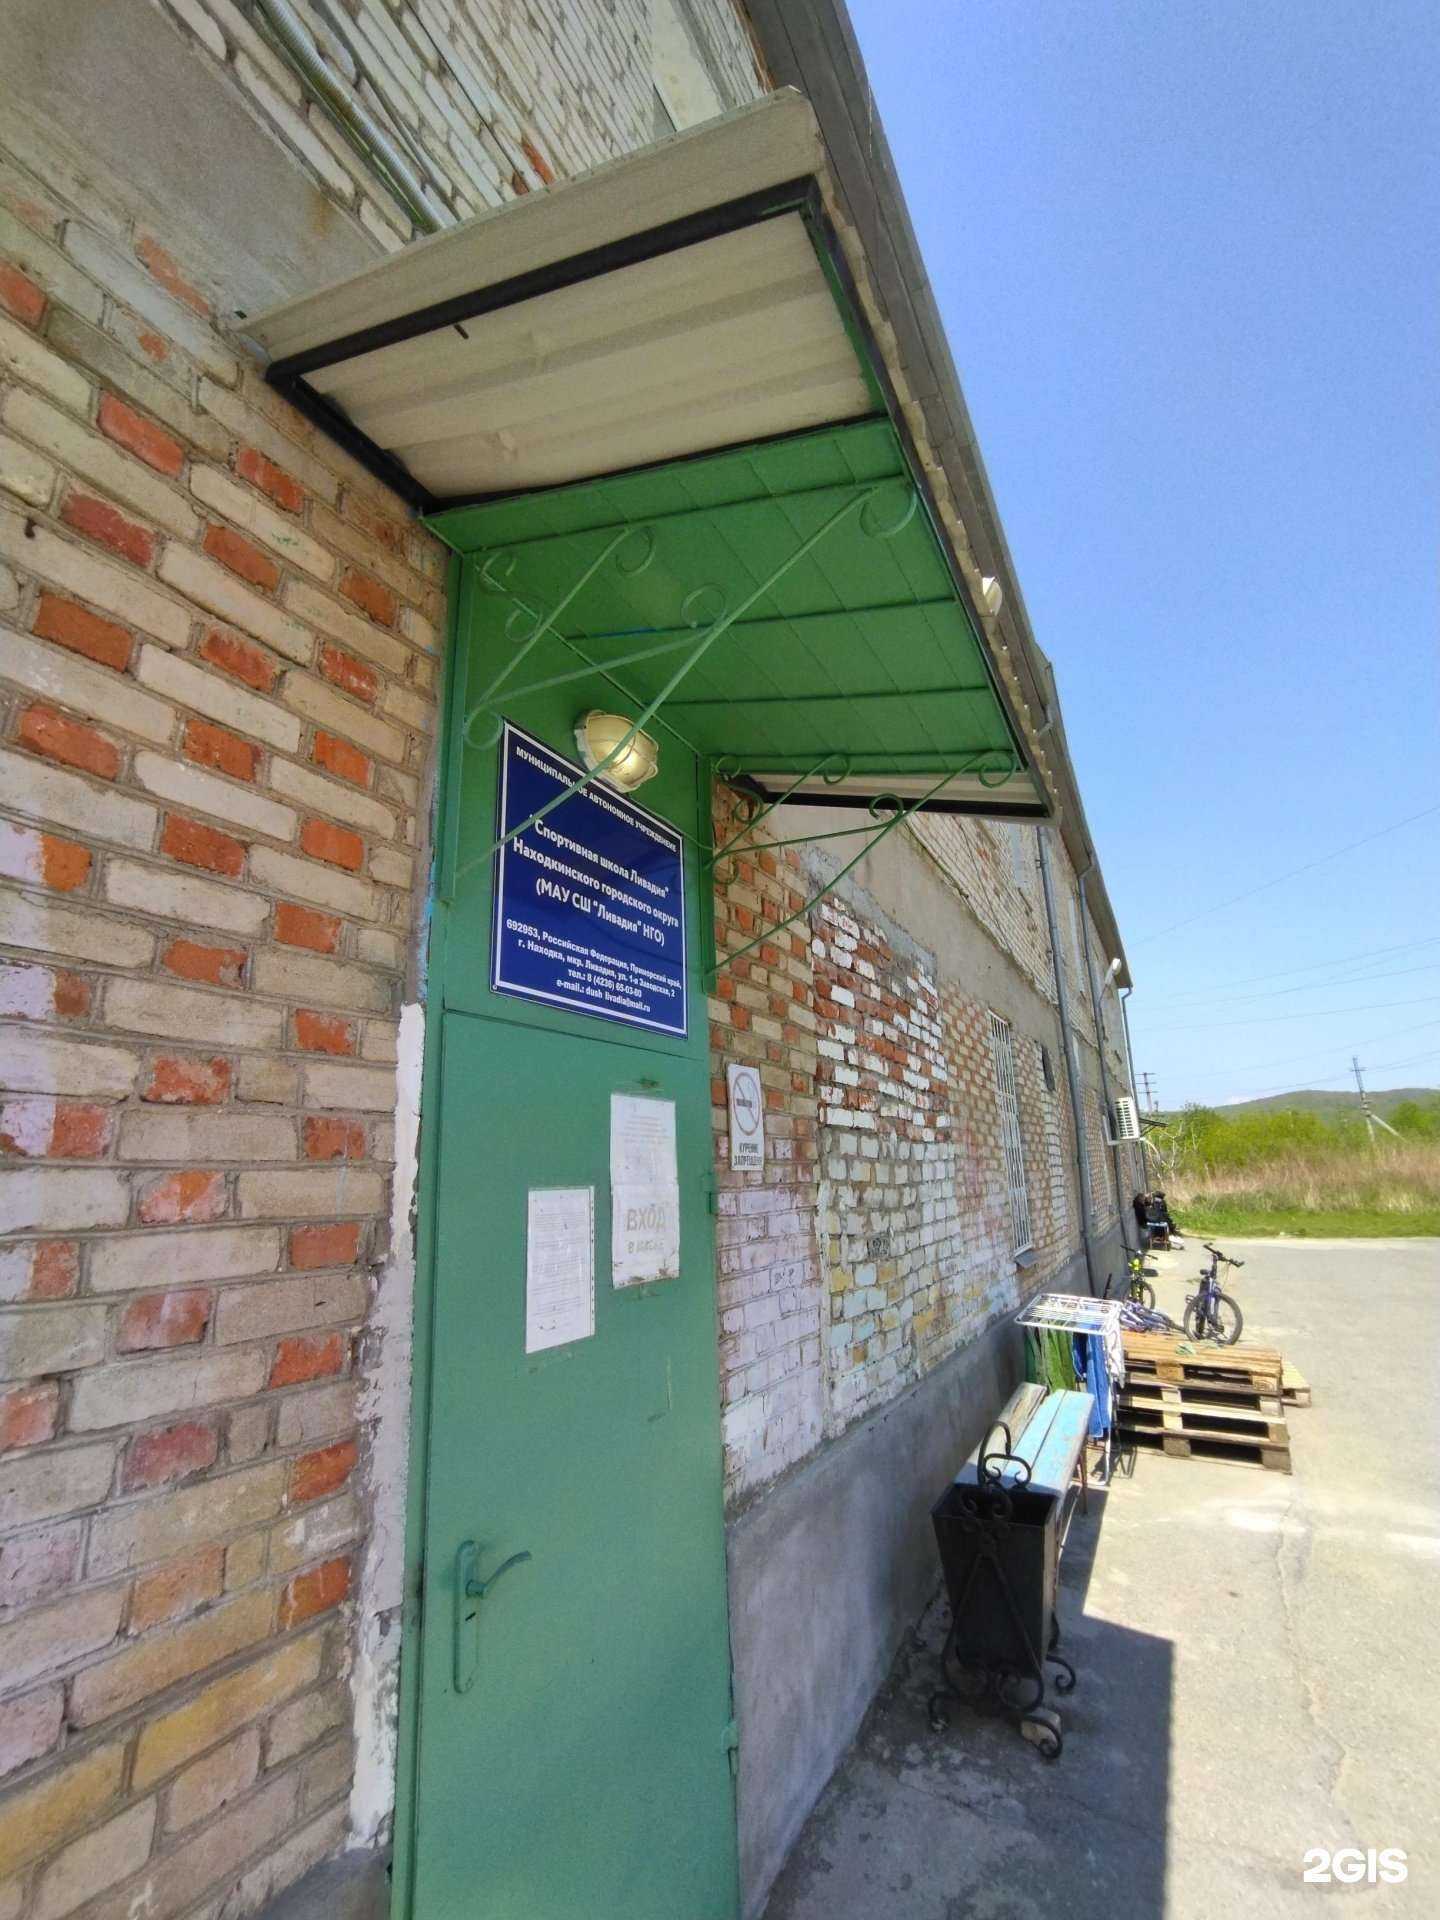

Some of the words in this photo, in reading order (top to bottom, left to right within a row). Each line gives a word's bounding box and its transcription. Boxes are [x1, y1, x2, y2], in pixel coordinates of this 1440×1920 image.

[588, 792, 635, 826] АВТОНОМНОЕ
[635, 820, 677, 852] УЧРЕЖДЕНИЕ
[513, 836, 600, 890] Находкинского
[601, 883, 652, 915] городского
[652, 908, 679, 928] округа
[600, 857, 629, 879] школа
[630, 869, 669, 898] Ливадия"
[536, 878, 570, 903] (МАУ
[572, 893, 591, 913] СШ
[593, 900, 642, 933] "Ливадия"
[642, 923, 665, 947] НГО)
[506, 918, 541, 940] 692953,
[542, 931, 589, 956] Российская
[590, 949, 630, 972] Федерация,
[518, 939, 526, 948] г.
[527, 940, 566, 962] Находка,
[566, 955, 584, 967] мкр.
[585, 959, 617, 979] Ливадия,
[671, 989, 676, 998] 2
[556, 979, 585, 994] e-mail.:
[568, 968, 586, 981] тел.:
[587, 973, 592, 982] 8
